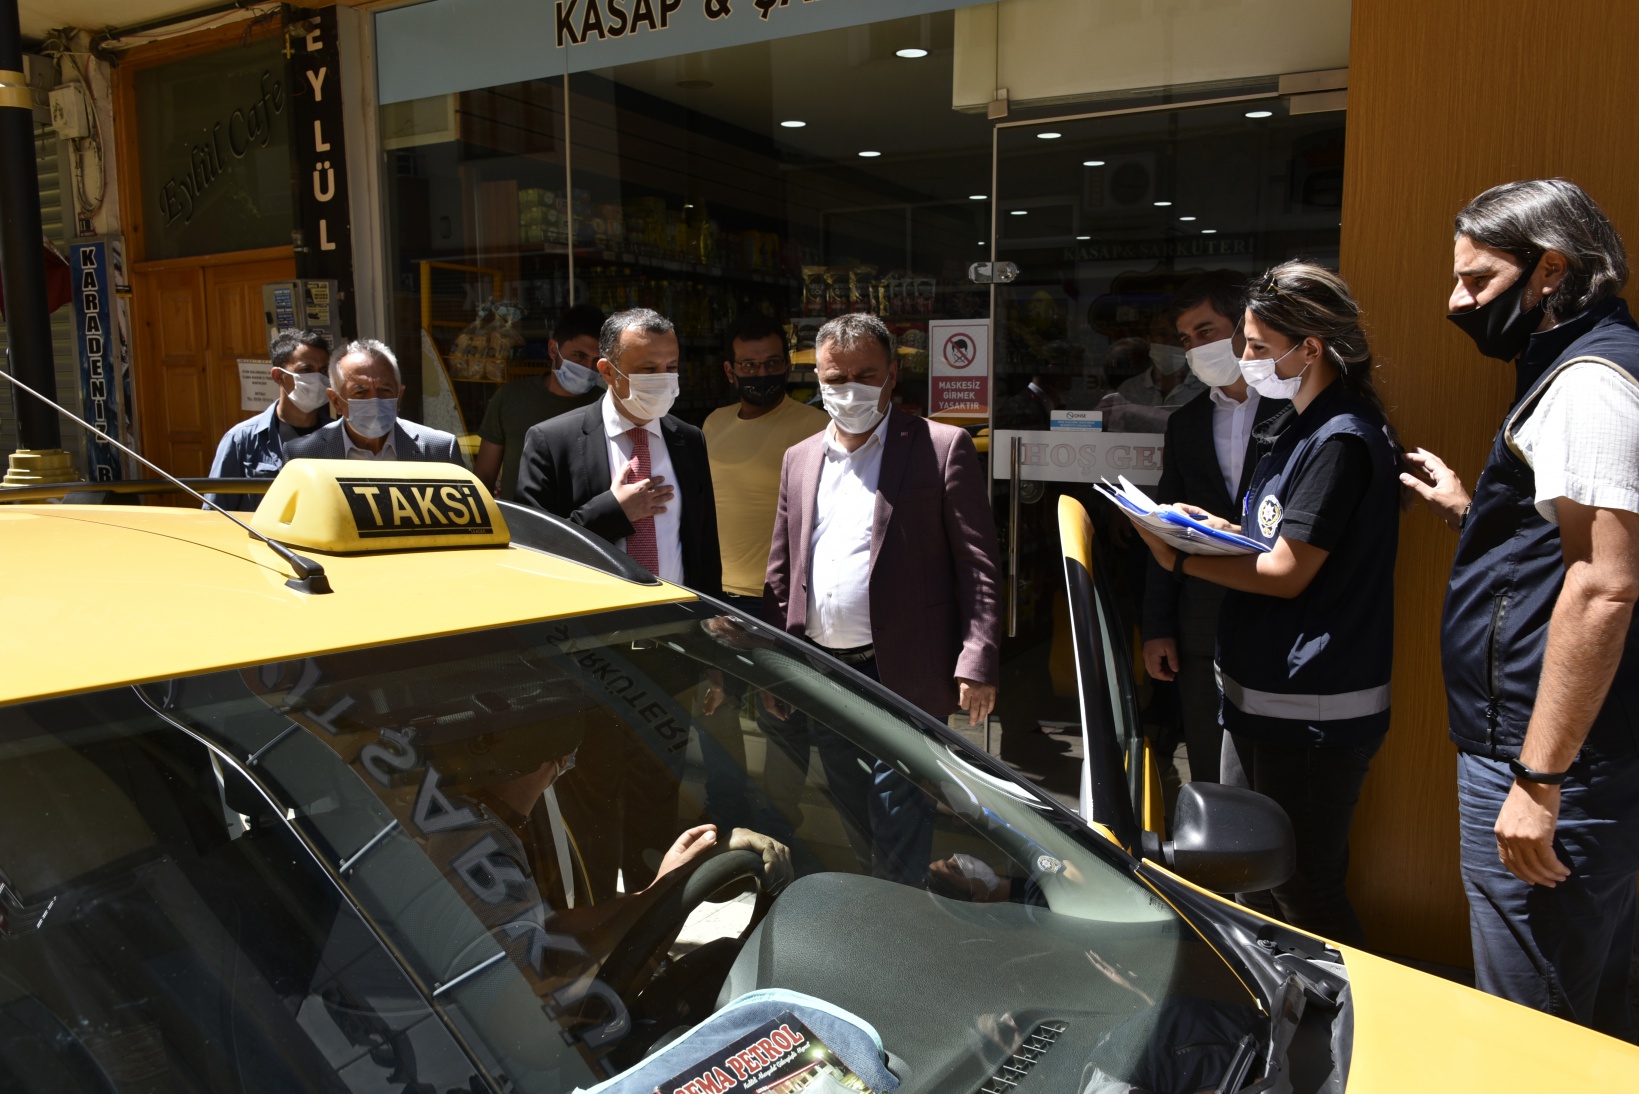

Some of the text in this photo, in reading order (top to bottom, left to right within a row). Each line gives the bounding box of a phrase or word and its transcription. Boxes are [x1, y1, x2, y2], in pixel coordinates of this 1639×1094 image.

[555, 0, 682, 48] KASAP
[159, 69, 285, 228] Eylül Cafe
[304, 16, 336, 251] EYLÜL
[79, 246, 110, 444] KARADENİZ
[938, 379, 981, 390] MASKESİZ
[938, 401, 980, 410] YASAKTIR
[943, 390, 975, 400] GİRMEK
[1021, 442, 1097, 476] HOŞ
[724, 1023, 805, 1081] PETROL
